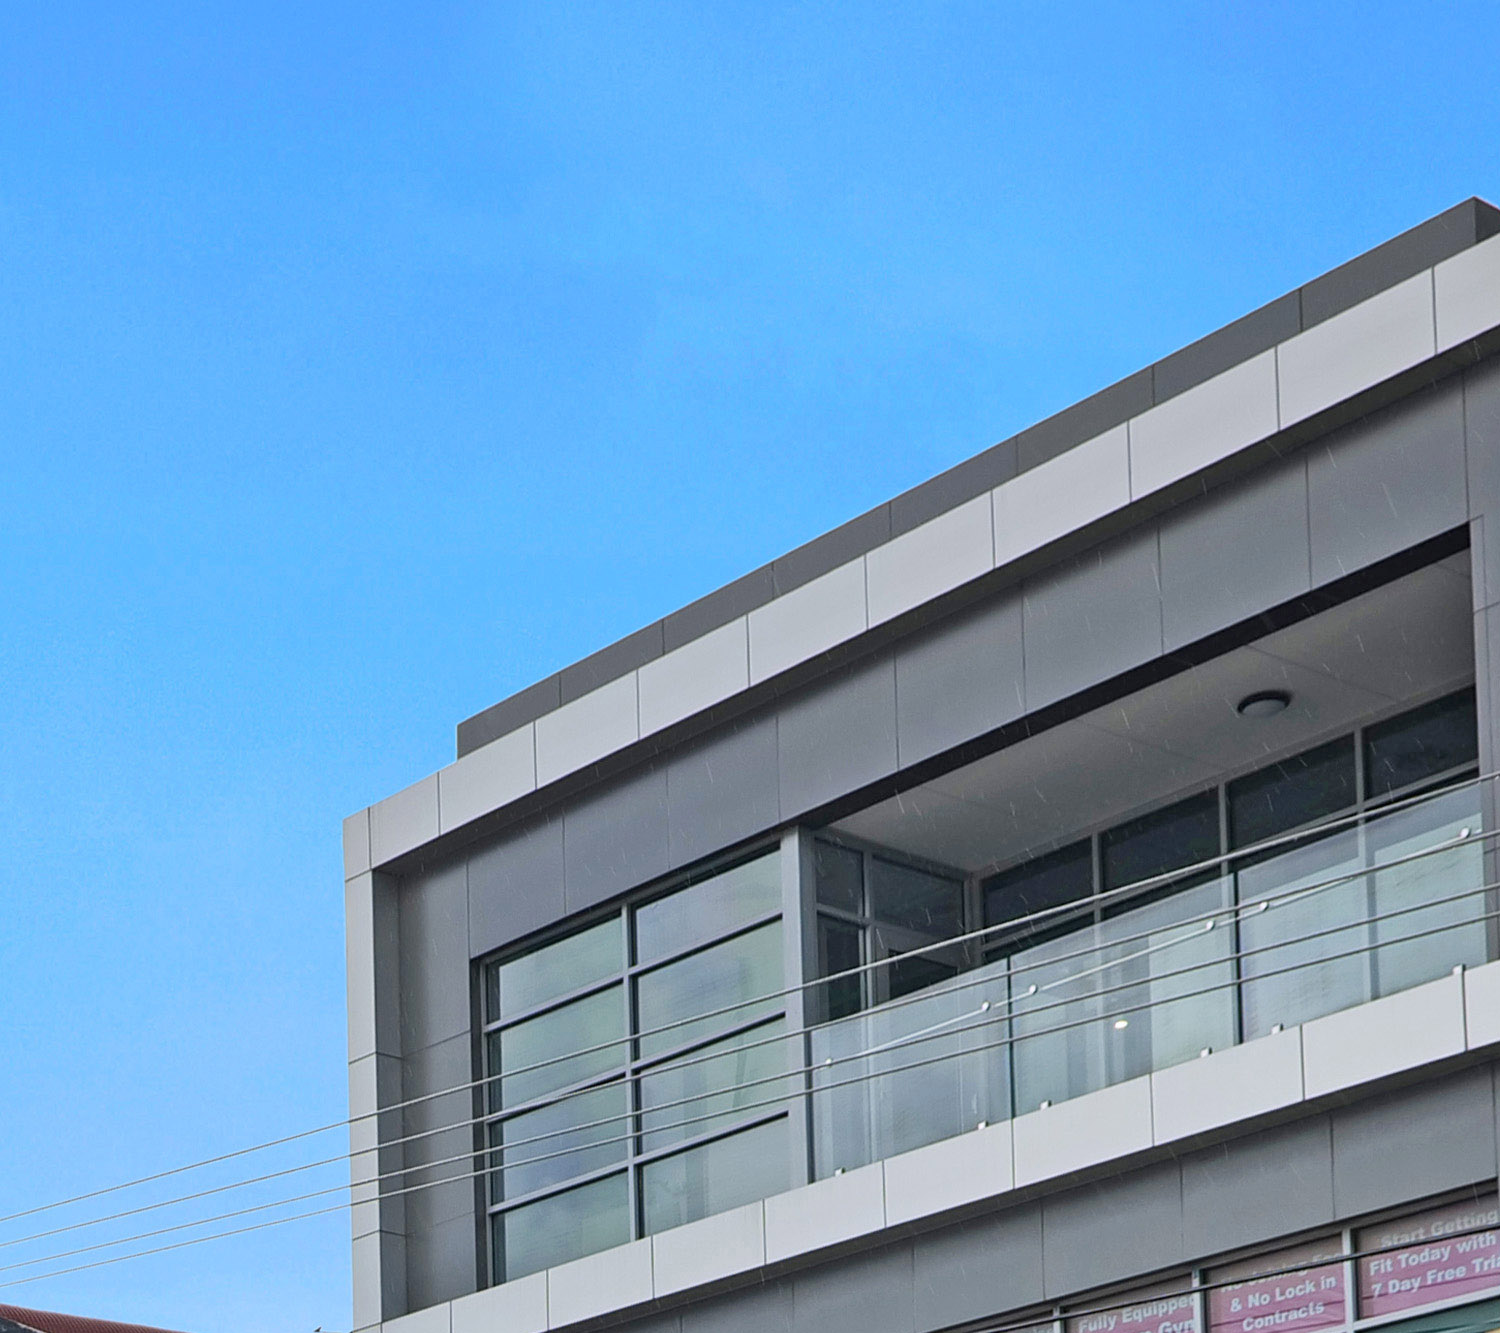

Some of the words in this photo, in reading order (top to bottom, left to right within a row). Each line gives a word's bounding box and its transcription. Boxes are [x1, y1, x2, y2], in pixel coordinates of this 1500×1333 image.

[1380, 1227, 1426, 1248] Start
[1430, 1209, 1499, 1236] Getting
[1369, 1260, 1393, 1275] Fit
[1399, 1244, 1451, 1268] Today
[1456, 1232, 1497, 1252] with
[1230, 1299, 1242, 1313] &
[1247, 1293, 1270, 1309] No
[1275, 1284, 1316, 1303] Lock
[1320, 1276, 1337, 1289] in
[1372, 1284, 1383, 1298] 7
[1388, 1276, 1421, 1295] Day
[1427, 1265, 1466, 1284] Free
[1242, 1301, 1325, 1331] Contracts
